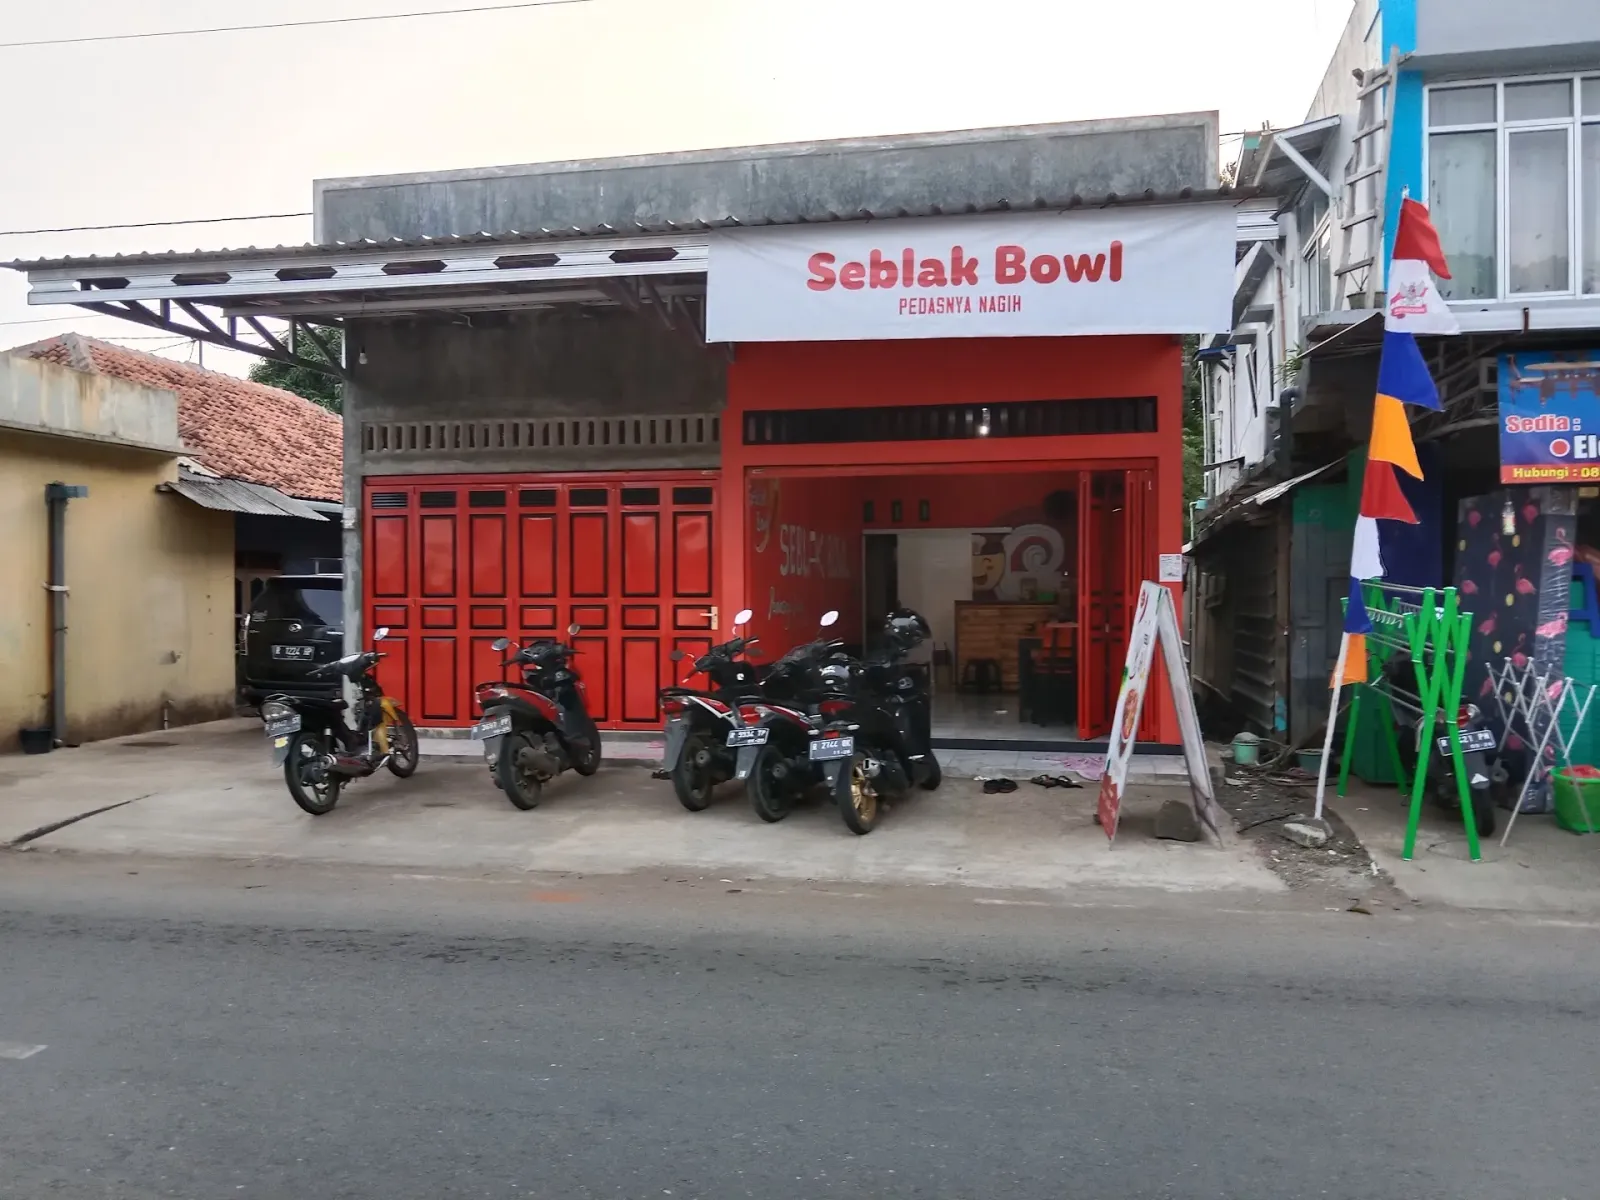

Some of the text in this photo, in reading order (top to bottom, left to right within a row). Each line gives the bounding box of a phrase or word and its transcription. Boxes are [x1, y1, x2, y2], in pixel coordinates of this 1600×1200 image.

[806, 240, 1123, 291] Seblak Bowl
[898, 295, 1022, 316] PEDASNYA NAGIH
[1573, 435, 1600, 459] El
[1512, 467, 1569, 479] Hubungi
